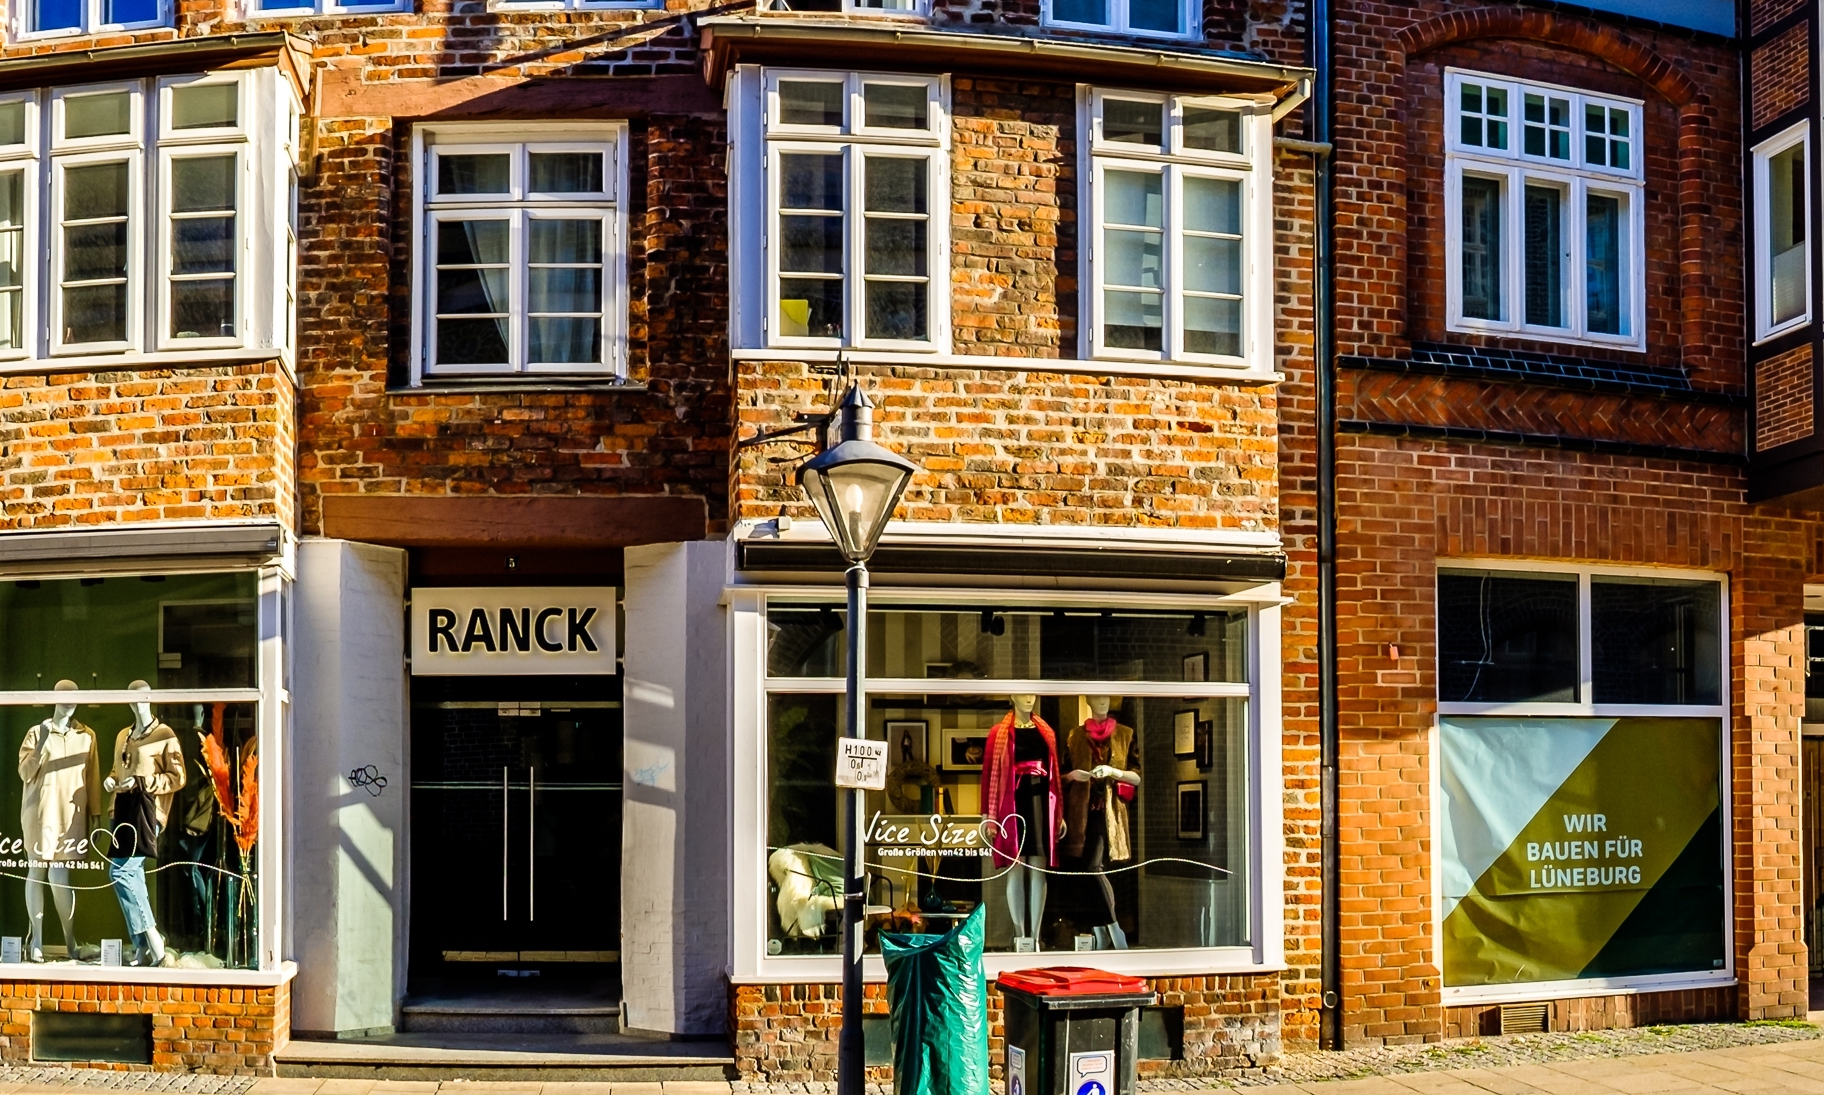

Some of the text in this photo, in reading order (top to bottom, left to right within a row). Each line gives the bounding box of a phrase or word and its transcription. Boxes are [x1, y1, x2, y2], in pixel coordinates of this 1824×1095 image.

[508, 557, 516, 568] 5
[428, 607, 598, 653] RANCK
[920, 814, 978, 845] Size
[1563, 813, 1607, 833] WIR
[33, 825, 89, 855] Size
[1527, 835, 1643, 861] BAUEN FÜR
[877, 847, 992, 857] Große Größen von 42 bis 54!
[18, 859, 48, 869] Größen
[49, 861, 64, 869] von
[65, 861, 76, 869] 42
[76, 860, 89, 870] bis
[89, 861, 104, 870] 54!
[1530, 865, 1641, 888] LÜNEBURG
